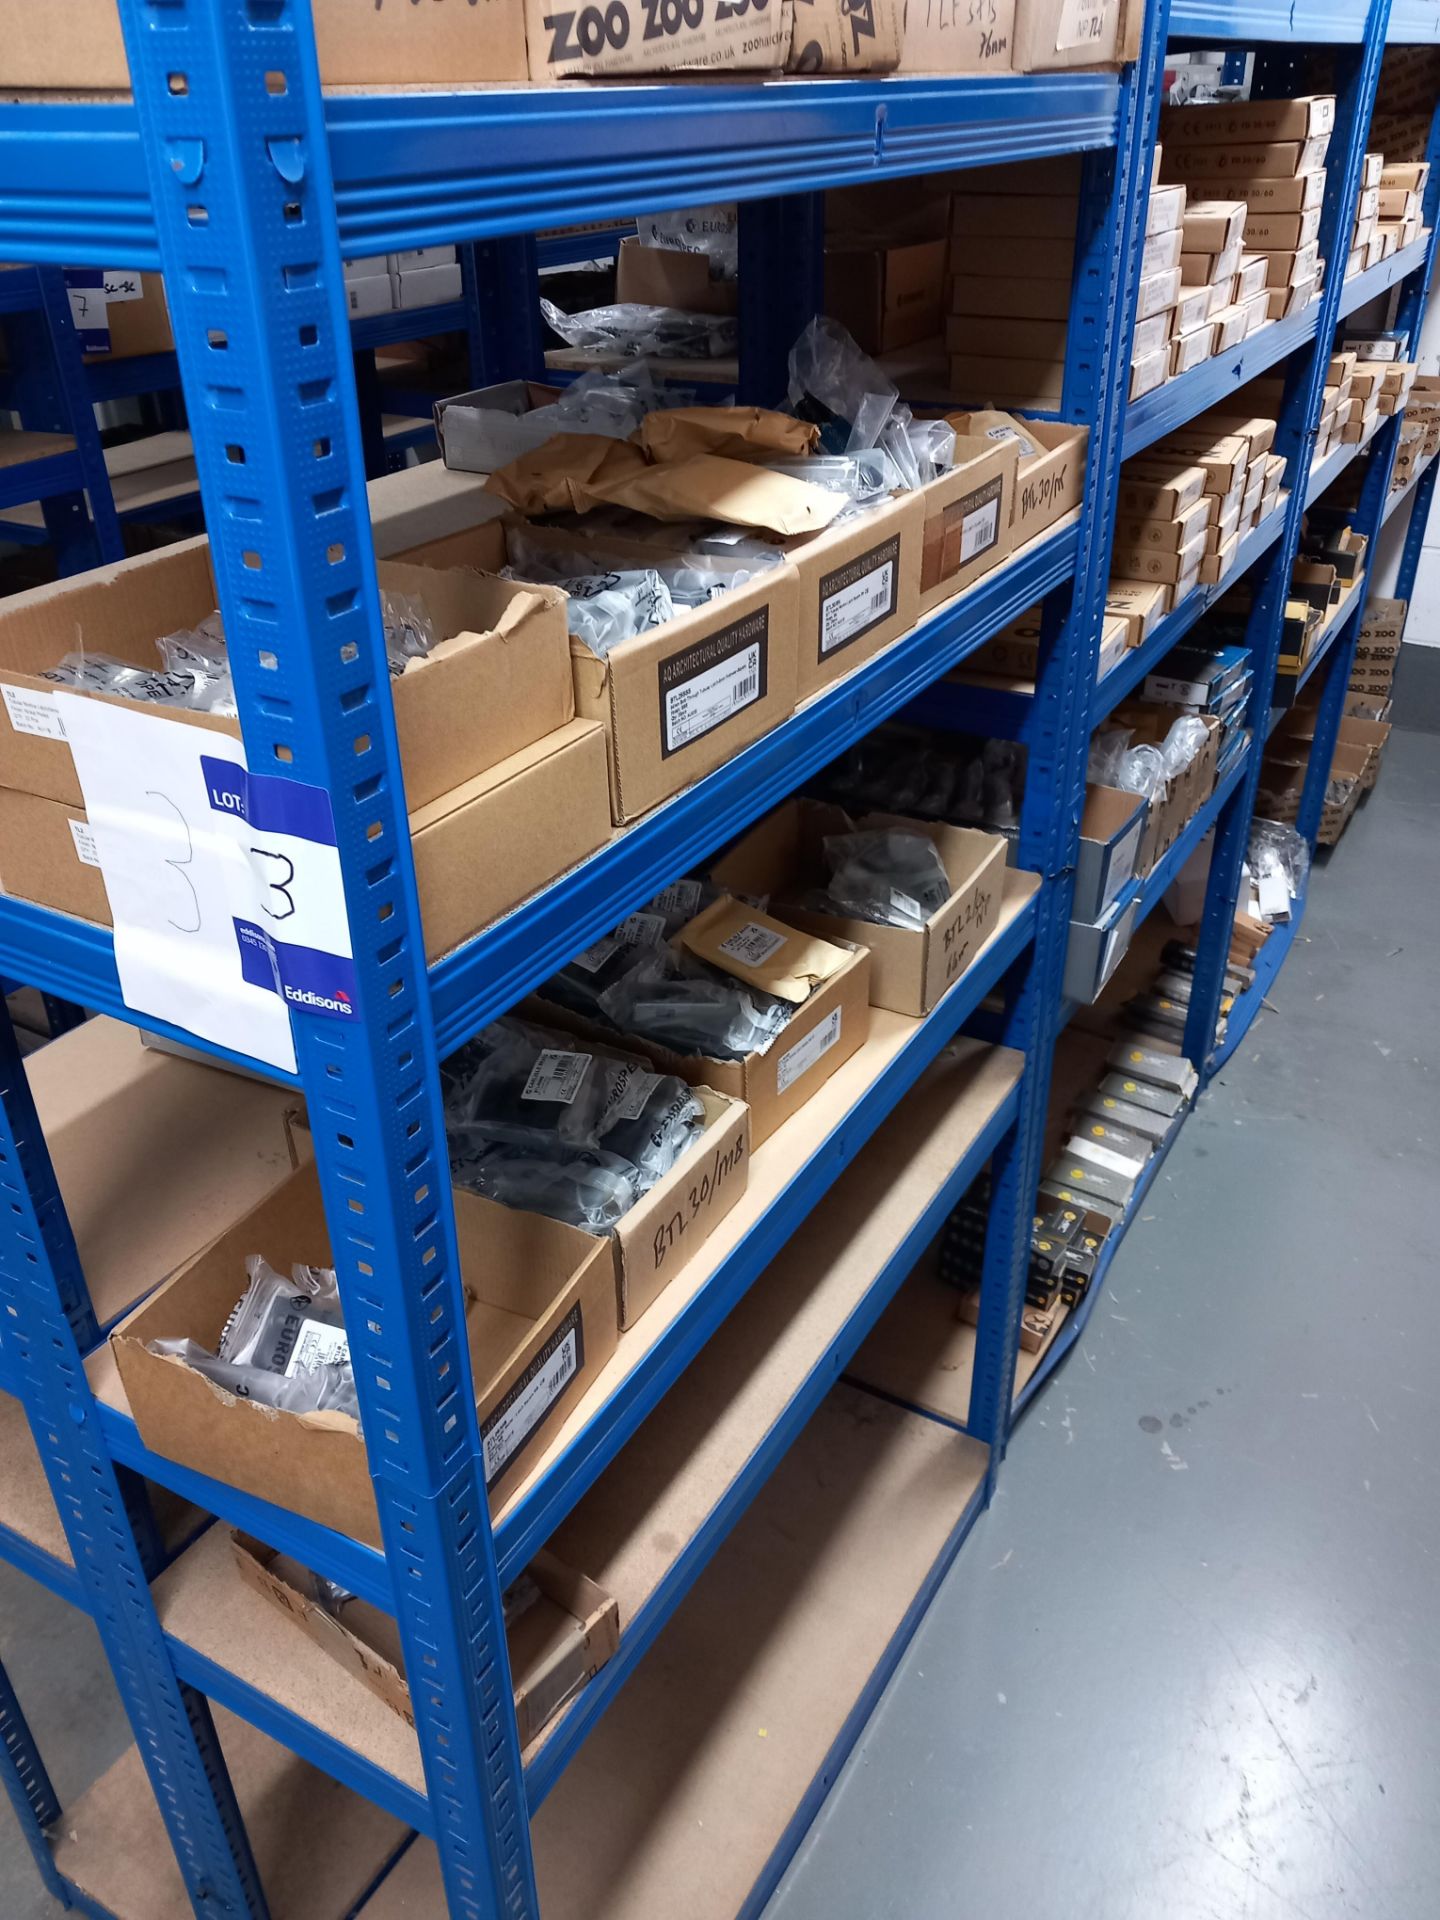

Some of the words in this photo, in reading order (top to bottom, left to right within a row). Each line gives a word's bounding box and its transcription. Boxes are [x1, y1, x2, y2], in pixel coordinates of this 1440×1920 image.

[543, 0, 630, 63] ZOO
[640, 0, 704, 41] ZOO
[73, 294, 89, 317] 7
[672, 640, 716, 680] ARCHITECTURAL
[717, 628, 738, 655] QUALITY
[738, 613, 764, 642] HARDWARE
[212, 787, 247, 814] LOT:
[144, 790, 202, 933] 3
[249, 847, 295, 920] 3
[284, 984, 353, 1015] Eddisons
